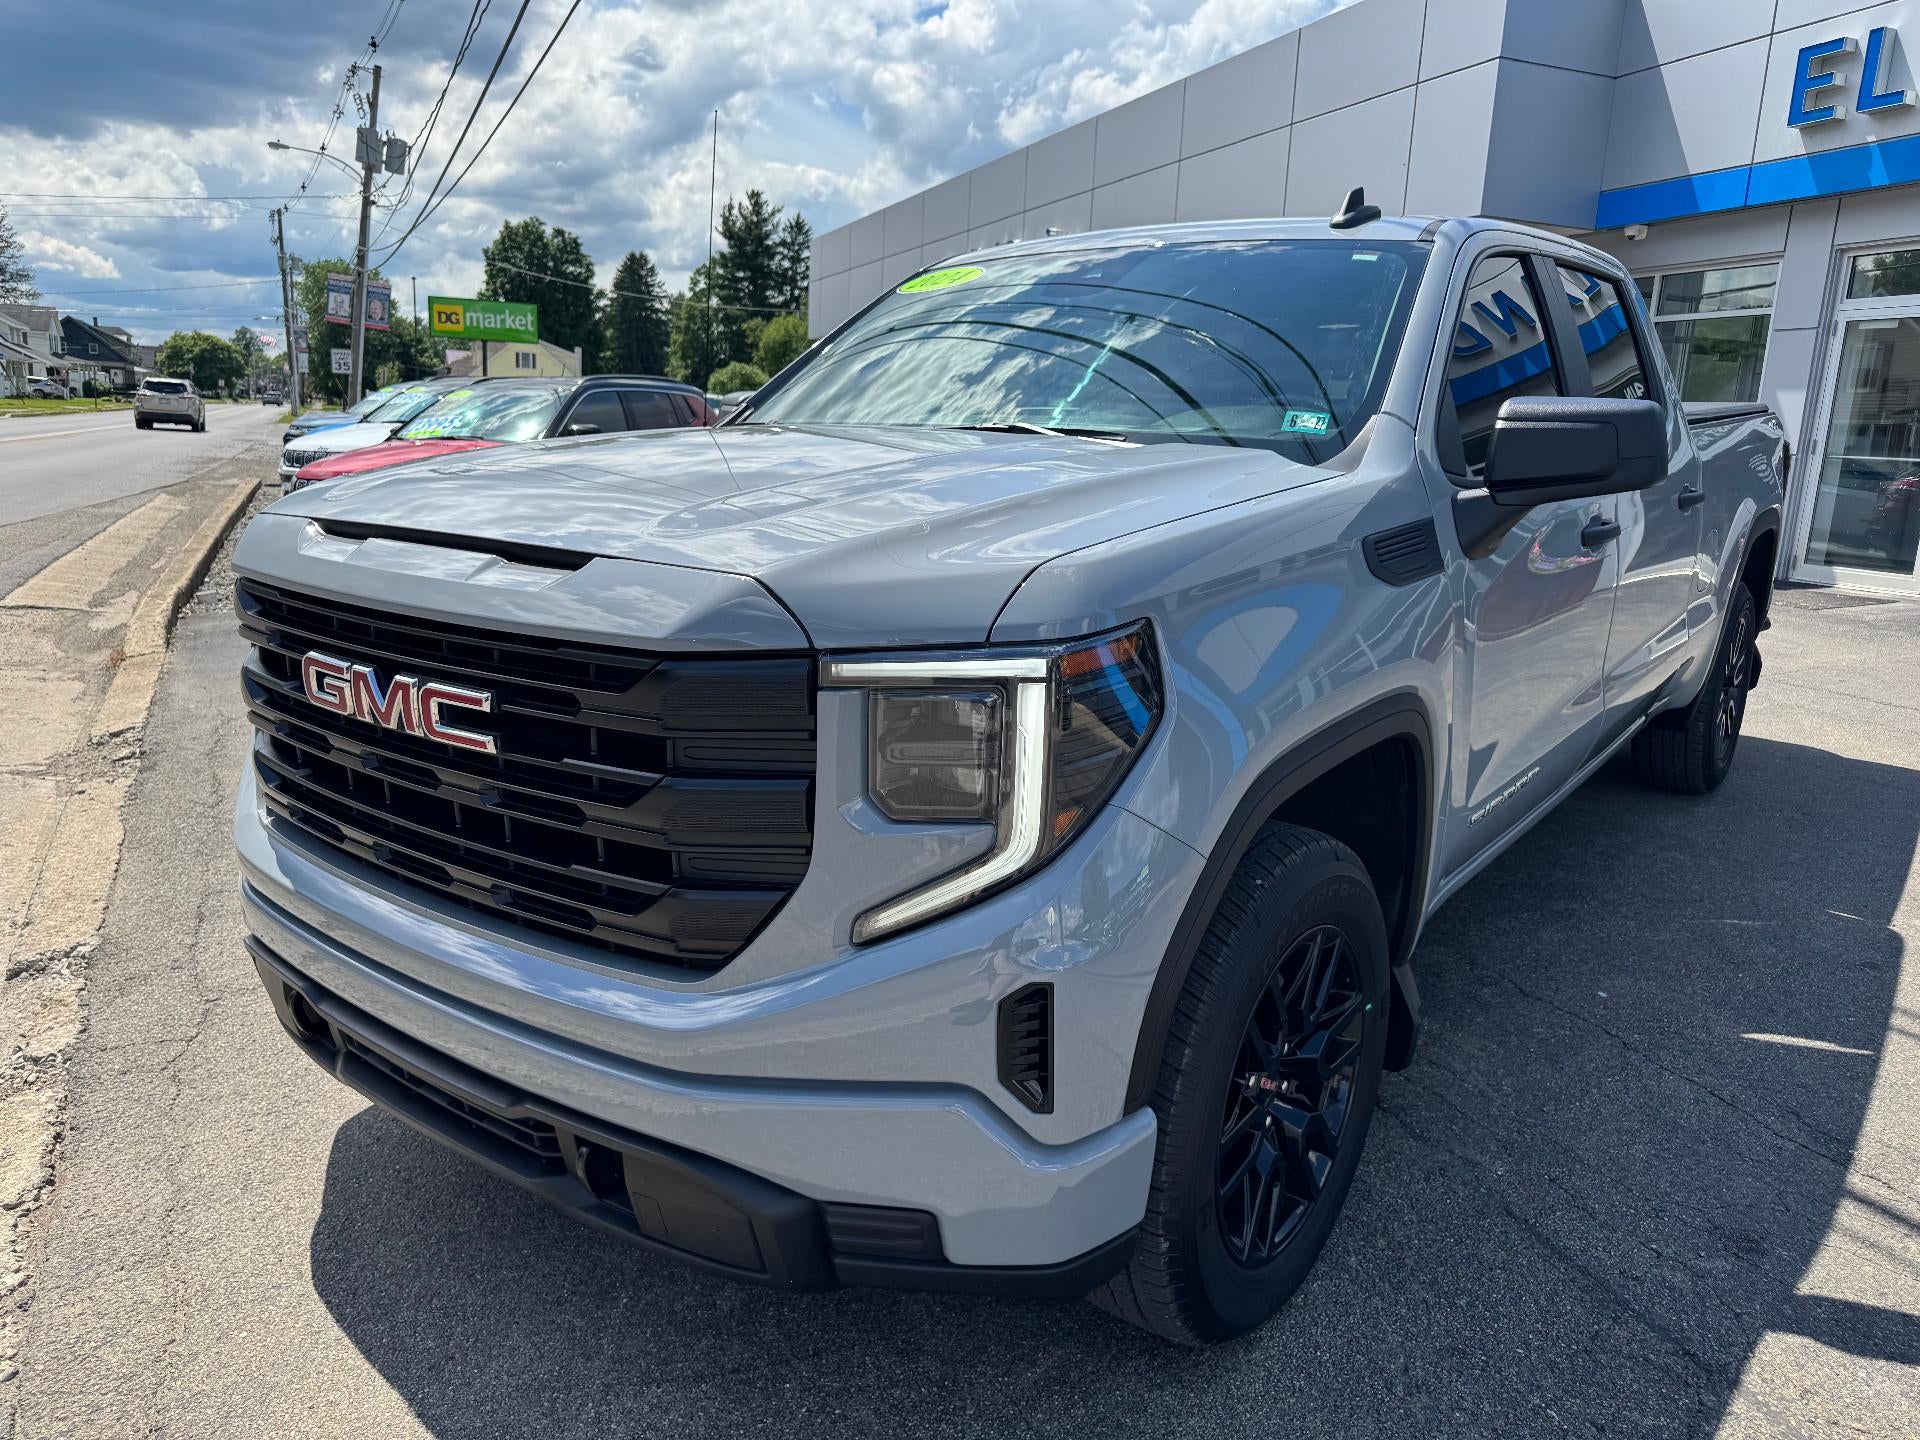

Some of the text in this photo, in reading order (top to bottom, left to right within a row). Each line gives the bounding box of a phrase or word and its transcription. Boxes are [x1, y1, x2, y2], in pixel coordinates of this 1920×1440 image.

[1787, 26, 1913, 128] EL
[437, 310, 535, 332] DG market
[335, 361, 350, 371] 35
[1289, 414, 1298, 428] 6
[302, 651, 497, 755] GMC
